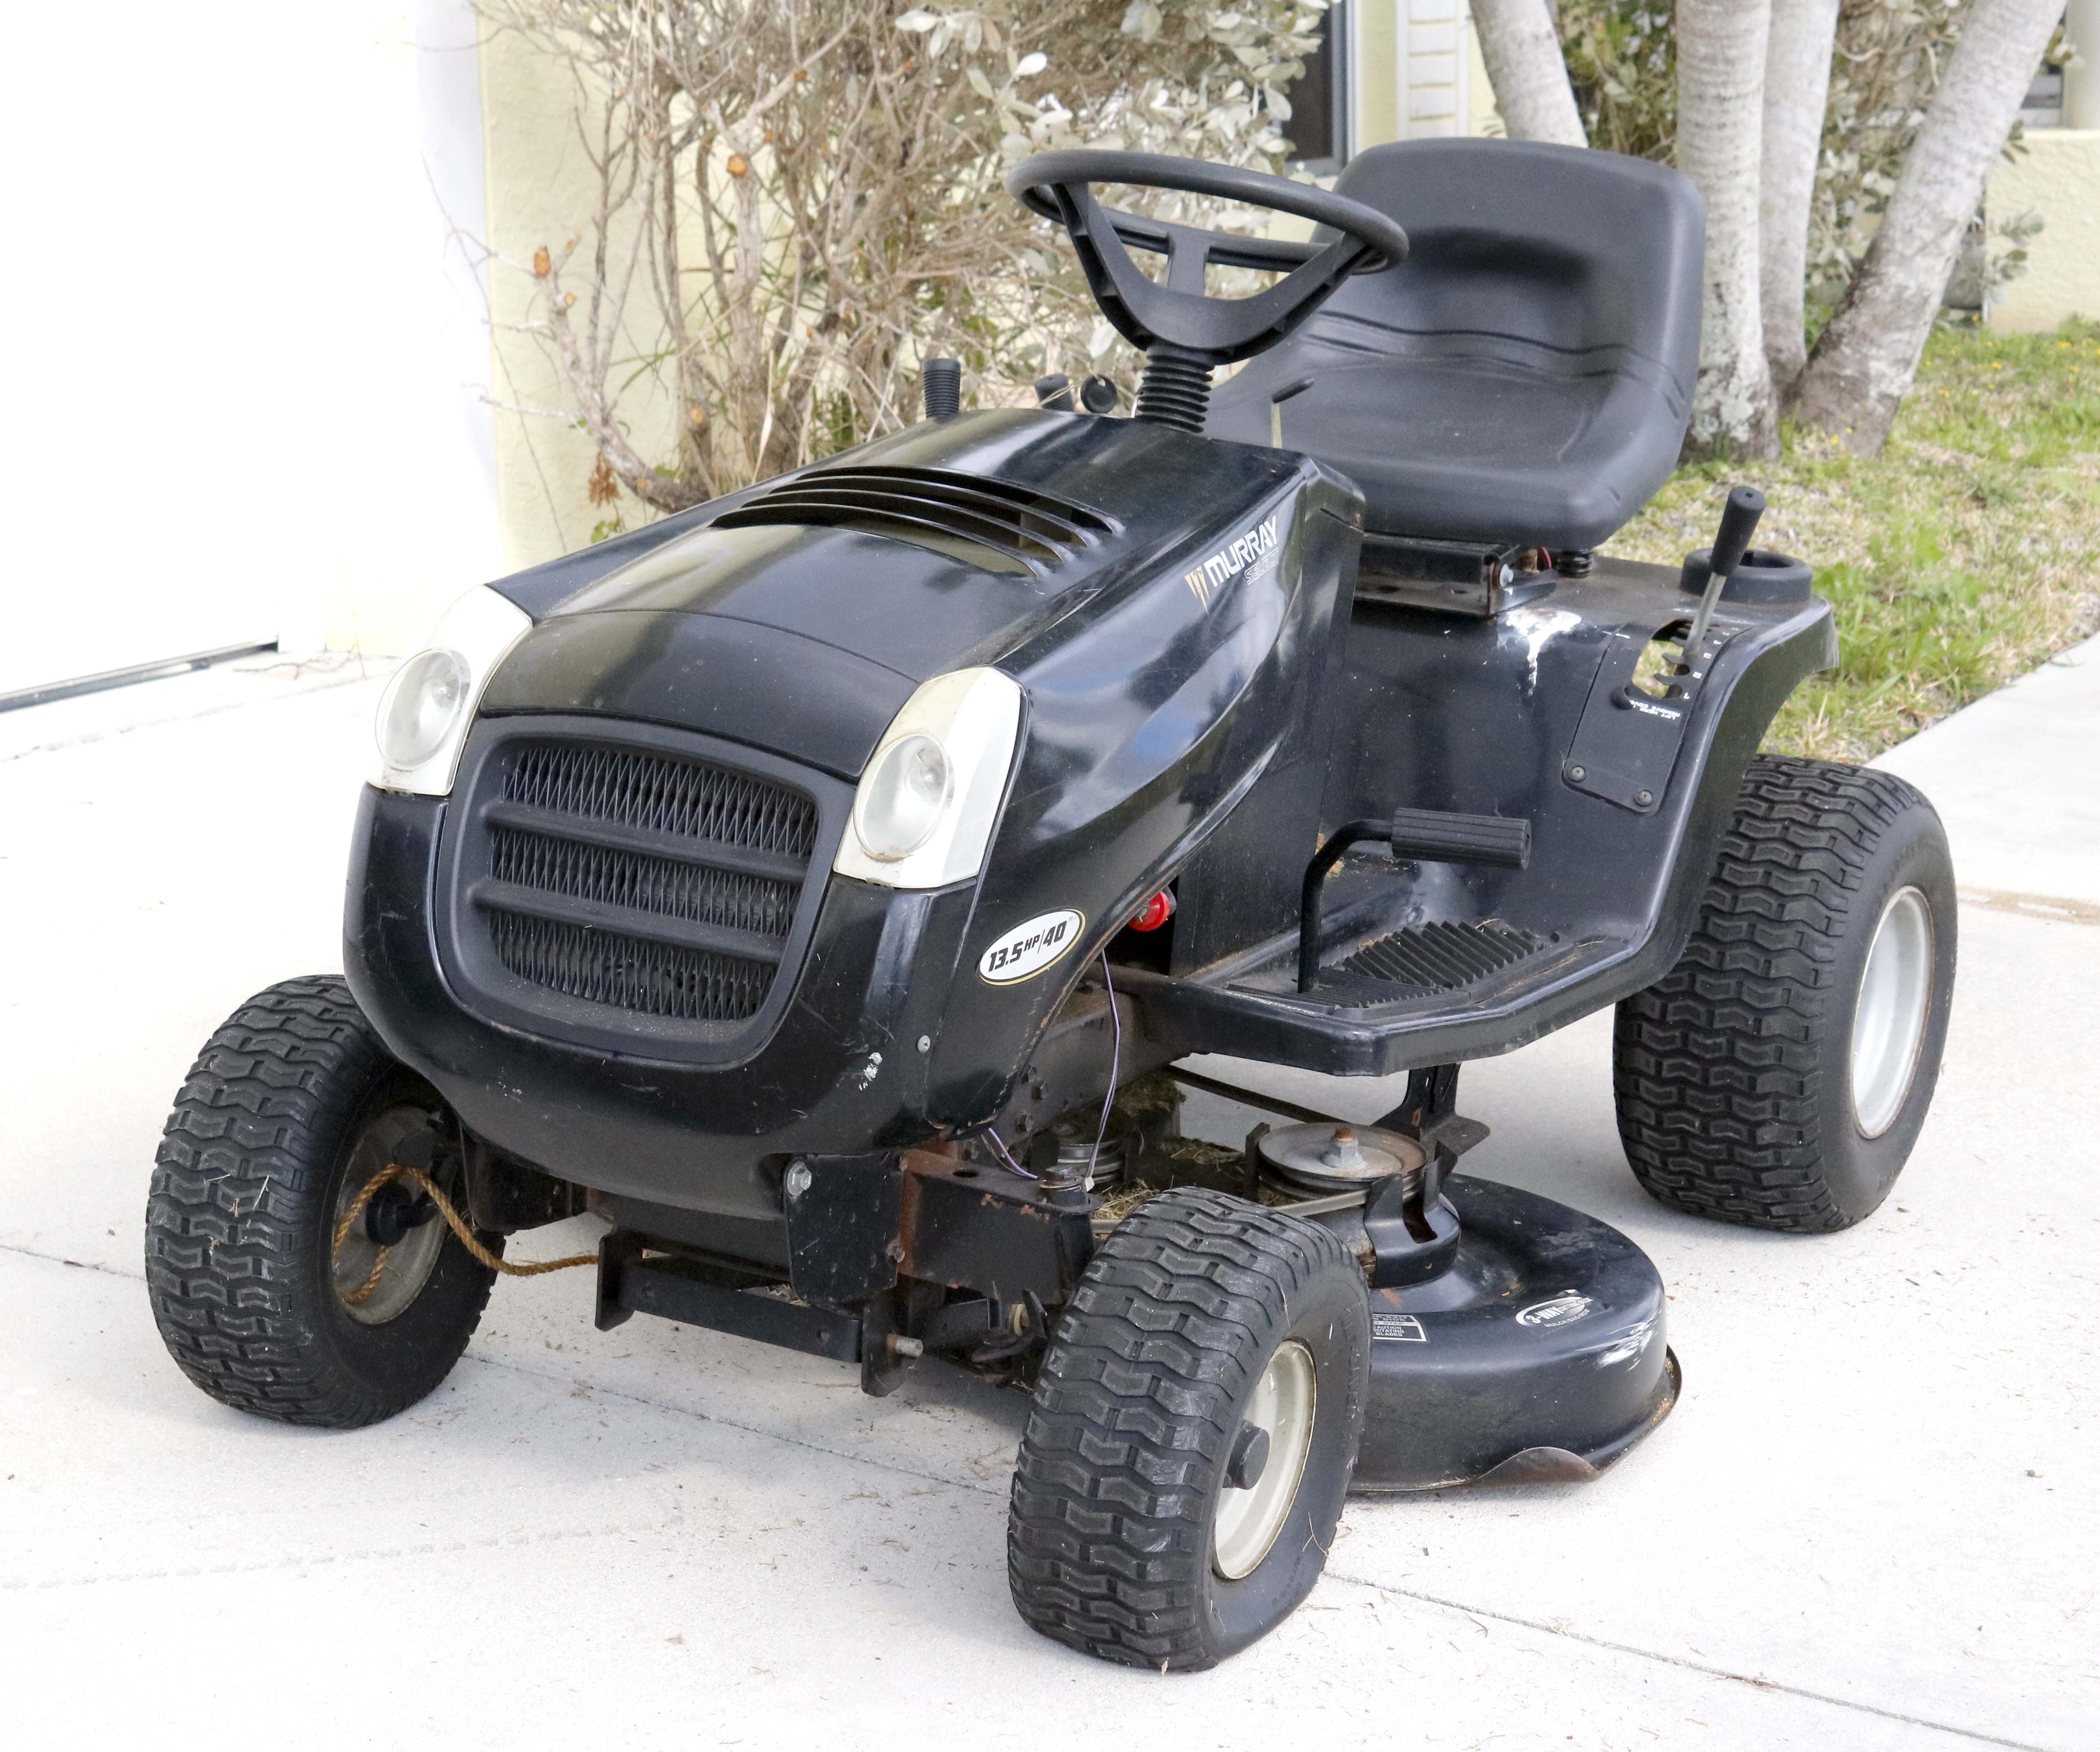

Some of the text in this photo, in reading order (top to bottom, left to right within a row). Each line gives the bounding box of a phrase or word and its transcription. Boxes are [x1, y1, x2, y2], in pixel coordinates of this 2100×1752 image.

[1203, 515, 1278, 587] MURRAY
[1244, 547, 1279, 585] SELECT
[1639, 707, 1659, 716] HERE
[1651, 705, 1680, 717] REMOVE
[1526, 1306, 1565, 1324] 3-WAY
